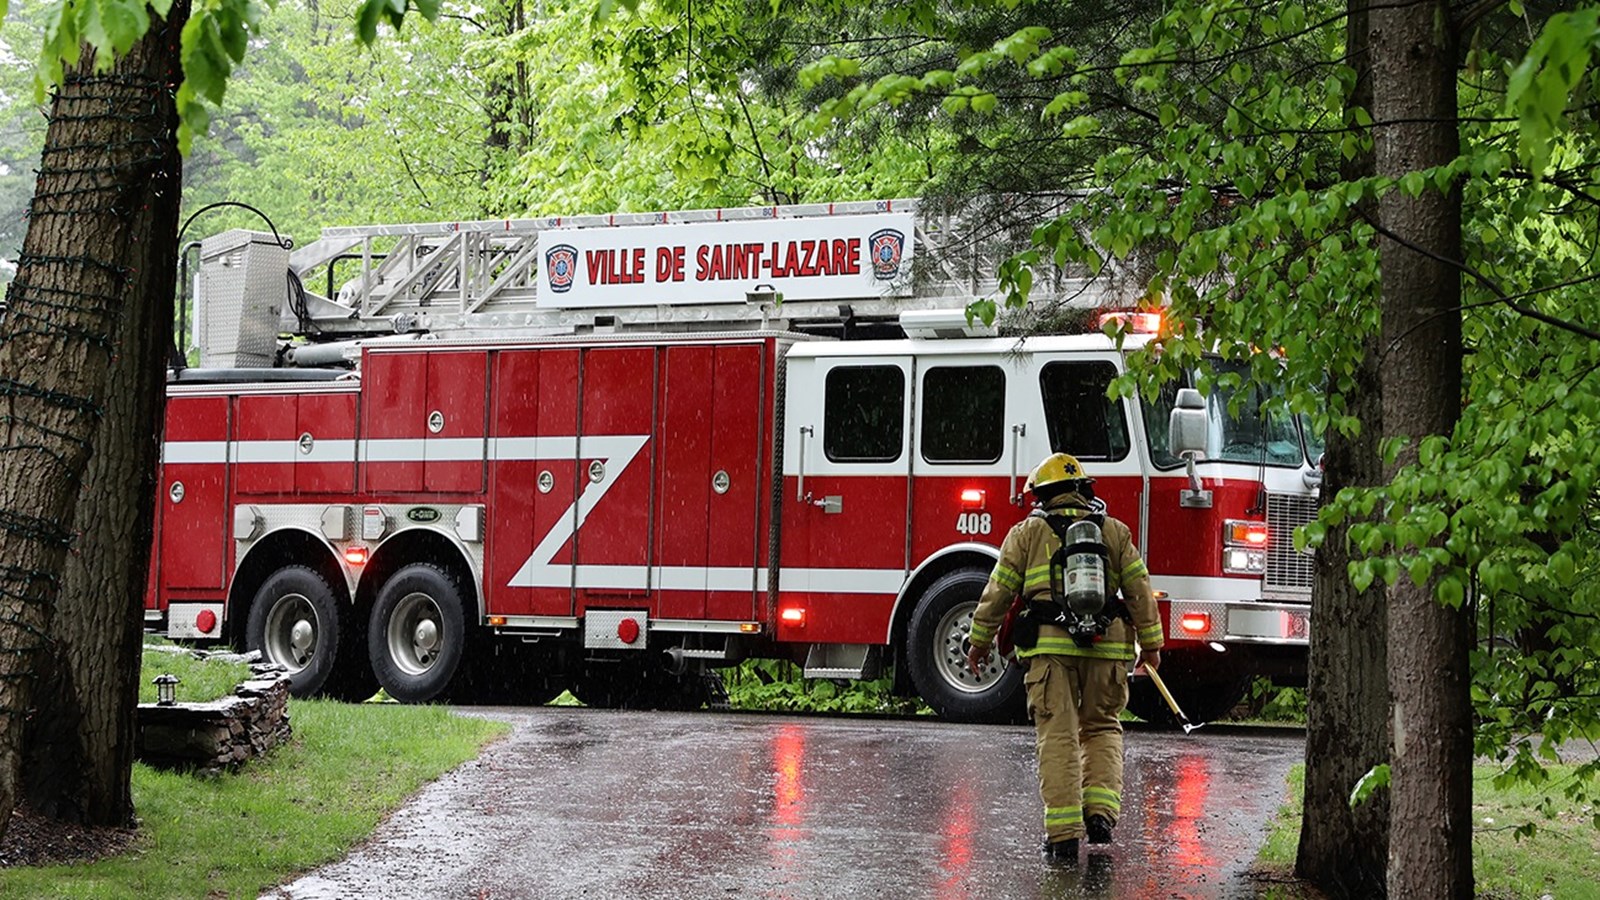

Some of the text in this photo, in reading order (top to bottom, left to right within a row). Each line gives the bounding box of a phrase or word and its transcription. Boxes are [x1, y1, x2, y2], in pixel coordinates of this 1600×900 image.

[762, 207, 772, 216] 80
[876, 201, 886, 210] 90
[585, 238, 861, 285] VILLE DE SAINT-LAZARE
[956, 512, 992, 535] 408
